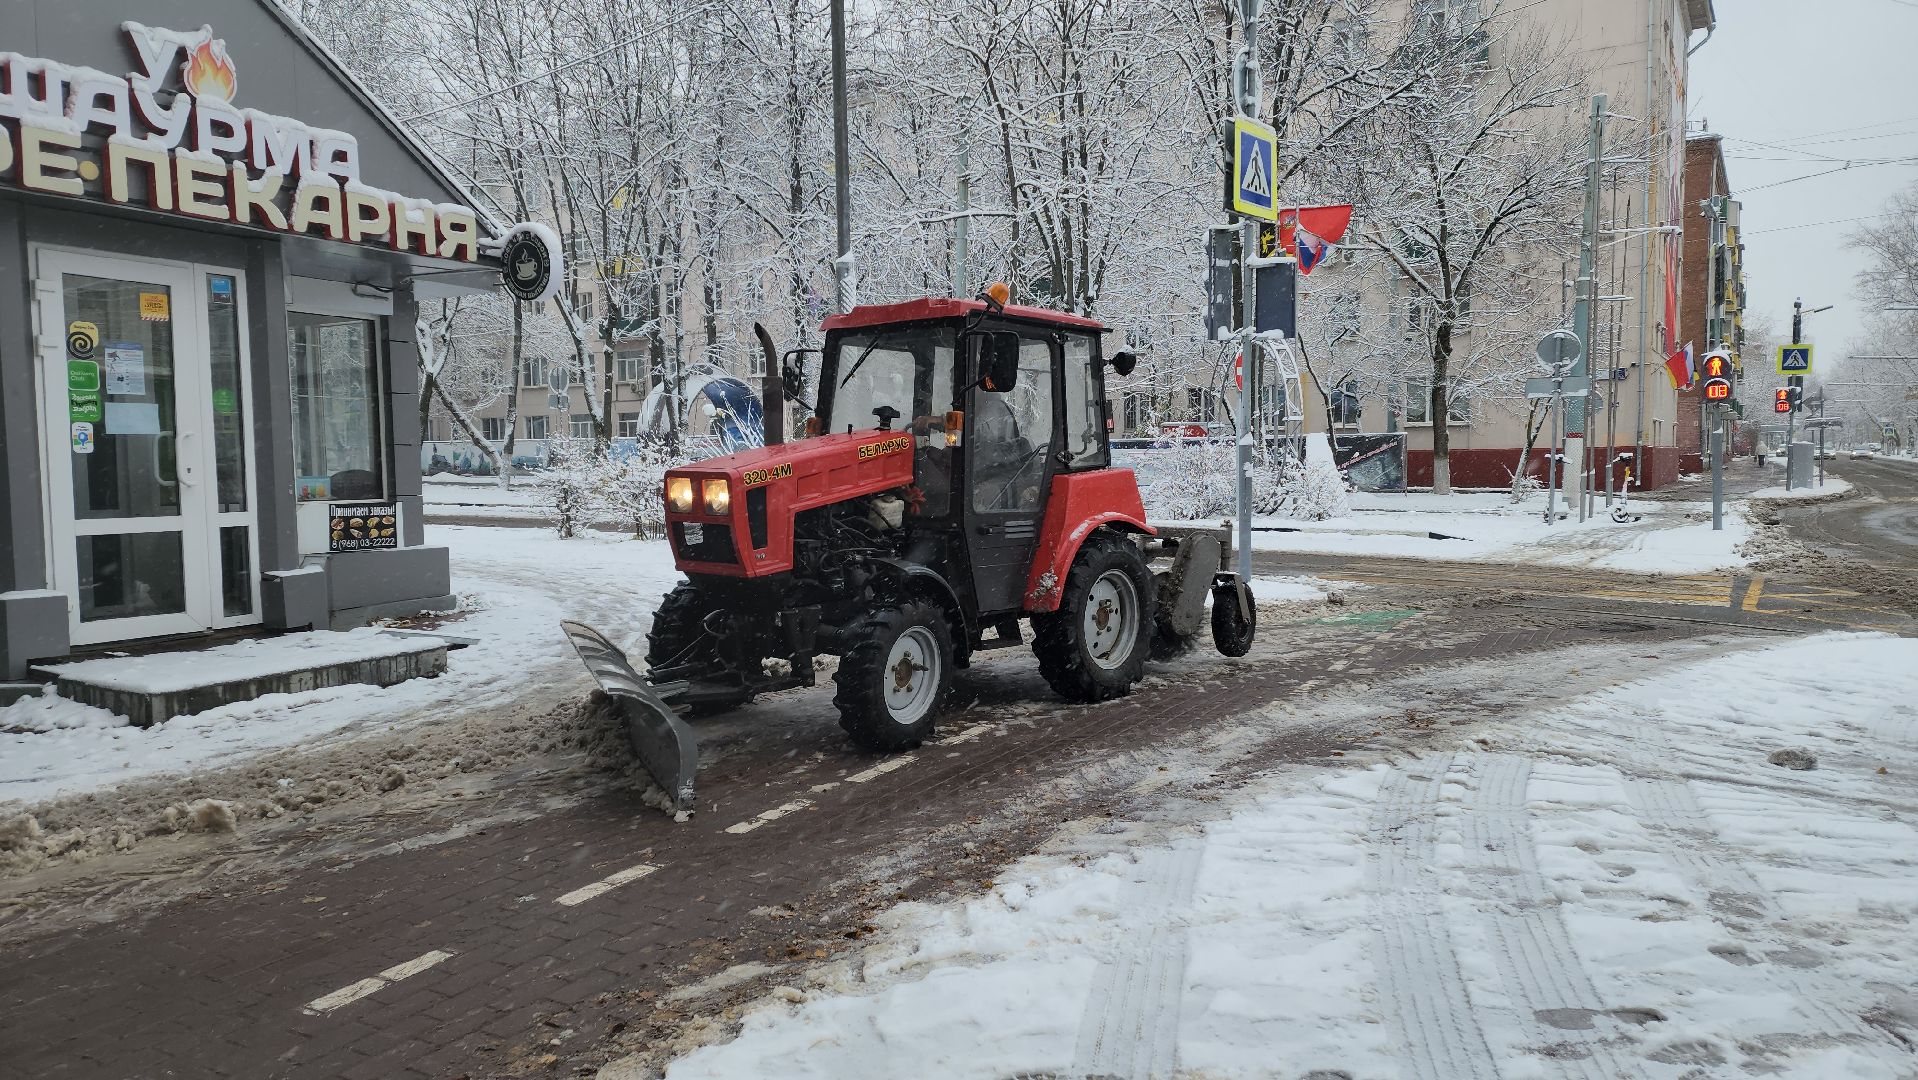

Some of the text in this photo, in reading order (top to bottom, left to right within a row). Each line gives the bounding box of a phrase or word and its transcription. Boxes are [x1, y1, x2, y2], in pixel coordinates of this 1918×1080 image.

[107, 138, 478, 262] ПЕКАРНЯ
[858, 437, 909, 459] БЕЛАРУС
[330, 504, 396, 518] Принимаем заказы!
[331, 537, 396, 550] 8 (968) 03-22222
